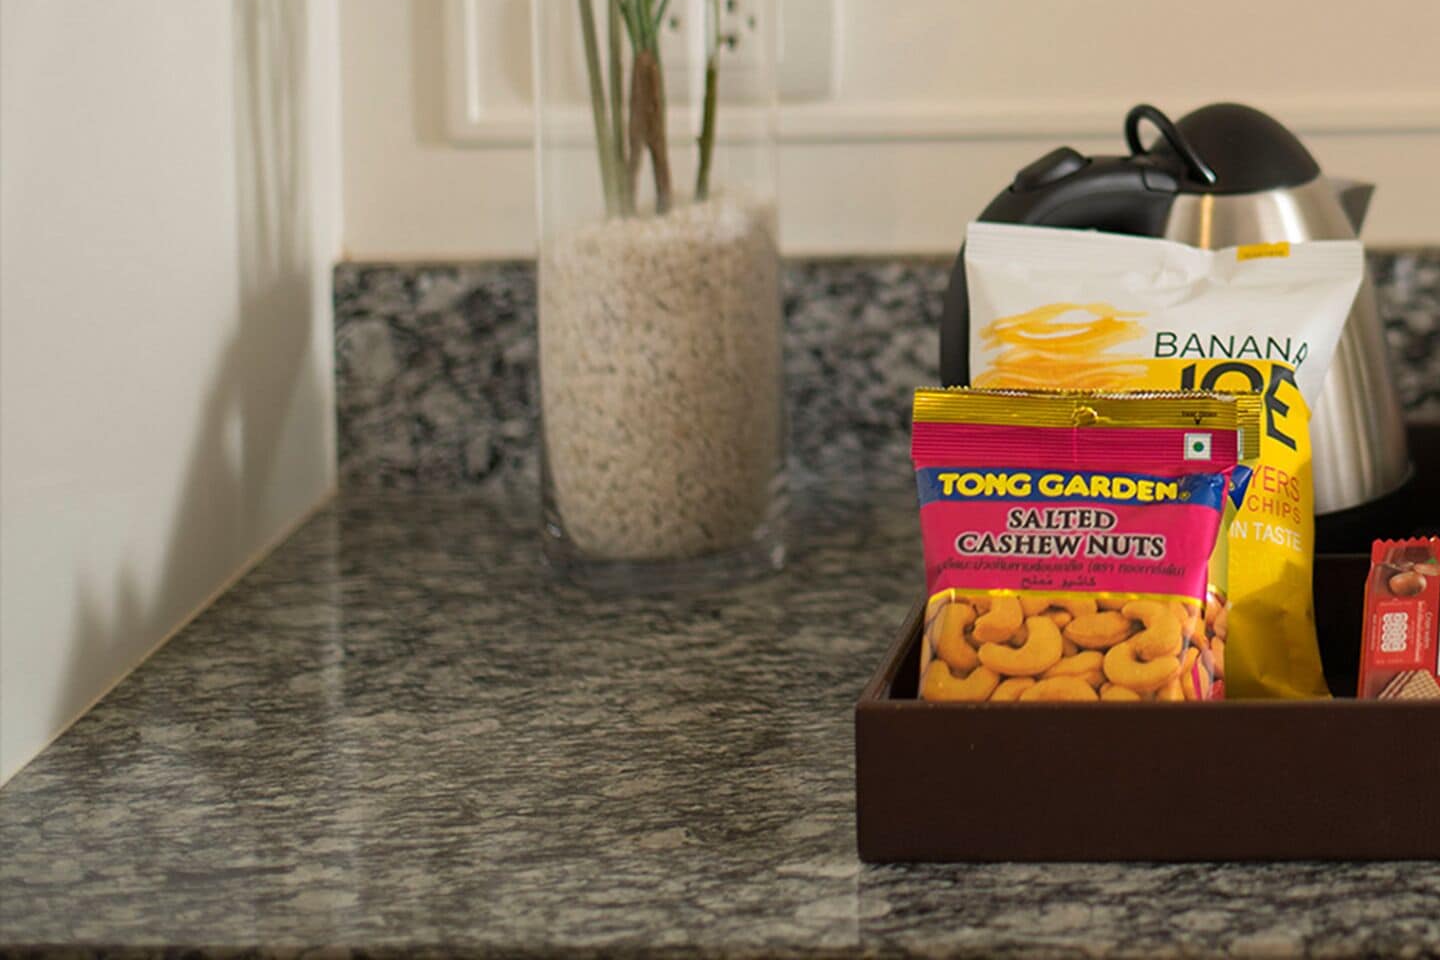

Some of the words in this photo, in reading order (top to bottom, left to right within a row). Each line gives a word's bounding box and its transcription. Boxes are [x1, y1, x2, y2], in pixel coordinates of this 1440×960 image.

[1154, 331, 1309, 369] BANANA
[937, 472, 1034, 497] TONG
[1038, 473, 1178, 501] GARDEN
[1009, 508, 1117, 529] SALTED
[1247, 494, 1302, 525] CHIPS
[957, 533, 1081, 556] CASHEW
[1087, 535, 1165, 558] NUTS
[1253, 521, 1304, 552] TASTE
